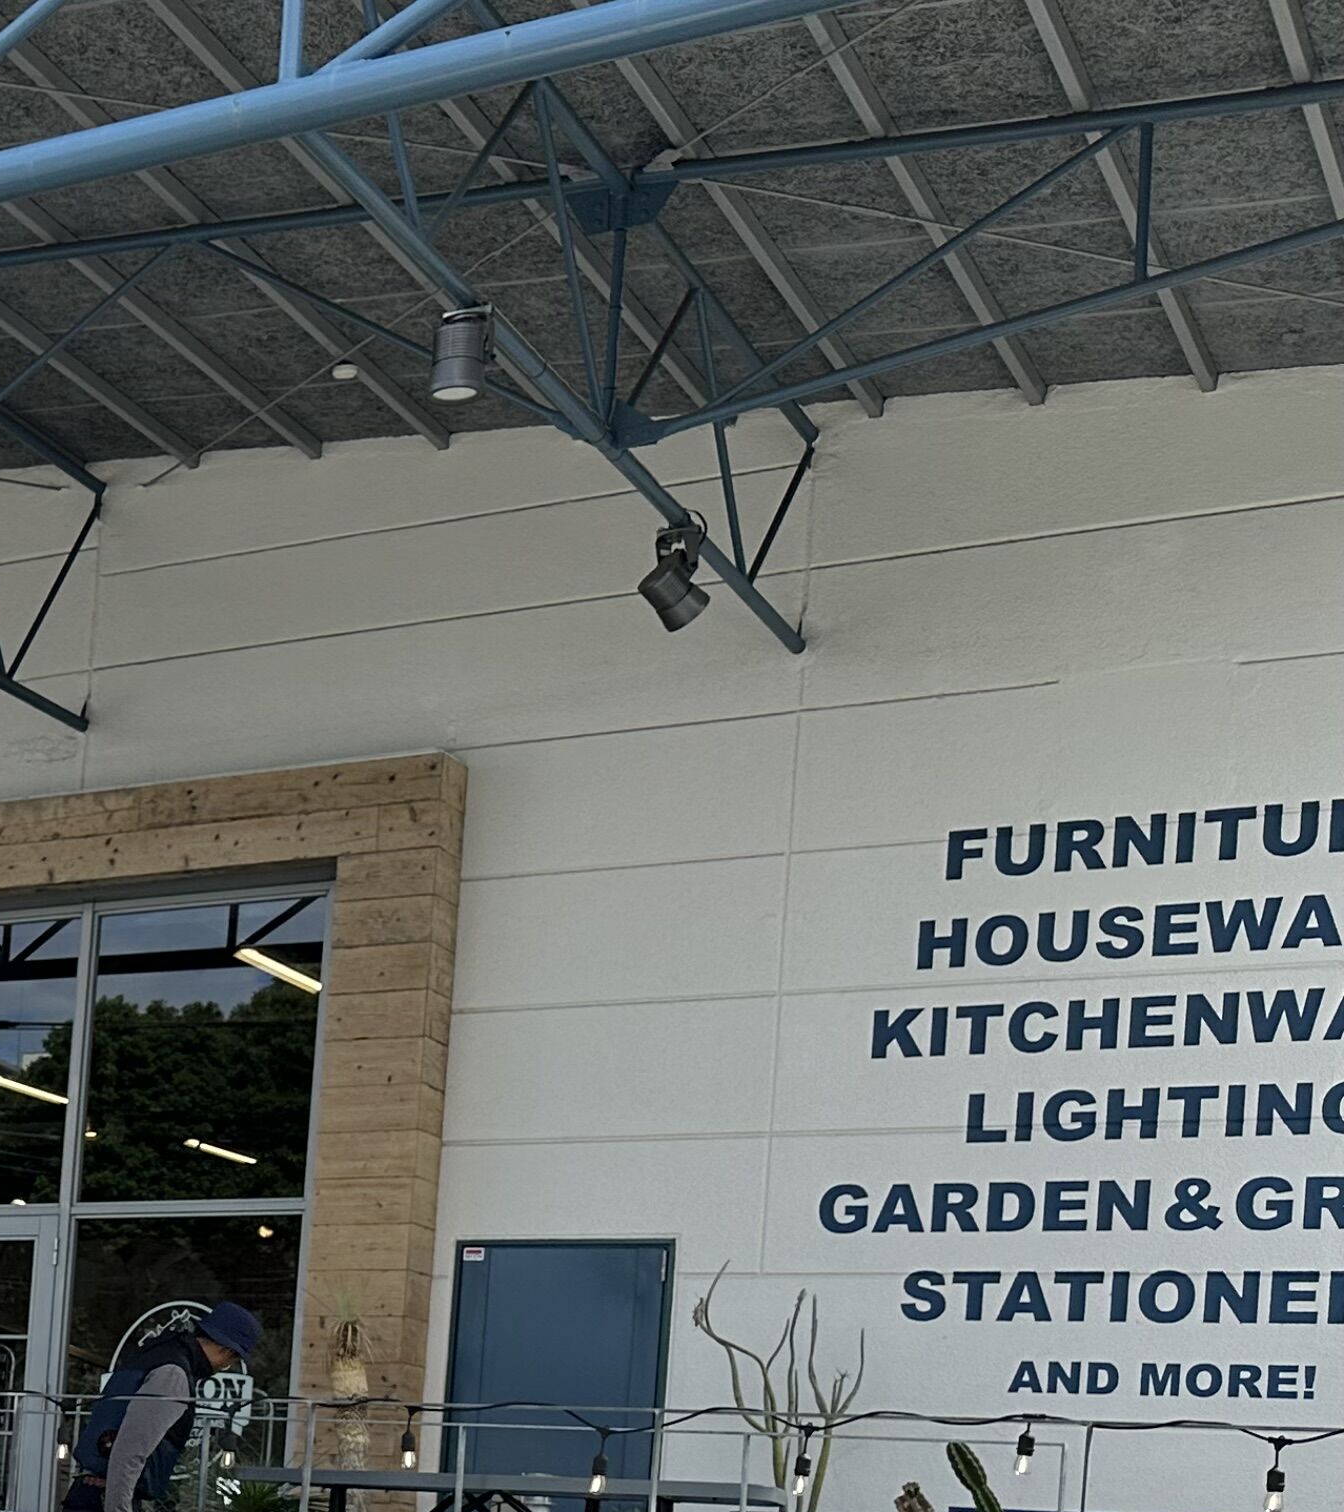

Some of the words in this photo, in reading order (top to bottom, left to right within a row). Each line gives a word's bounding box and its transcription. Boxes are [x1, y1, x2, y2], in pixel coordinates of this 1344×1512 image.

[917, 894, 1343, 970] HOUSEWA
[1007, 1361, 1120, 1395] AND
[1139, 1363, 1317, 1400] MORE!
